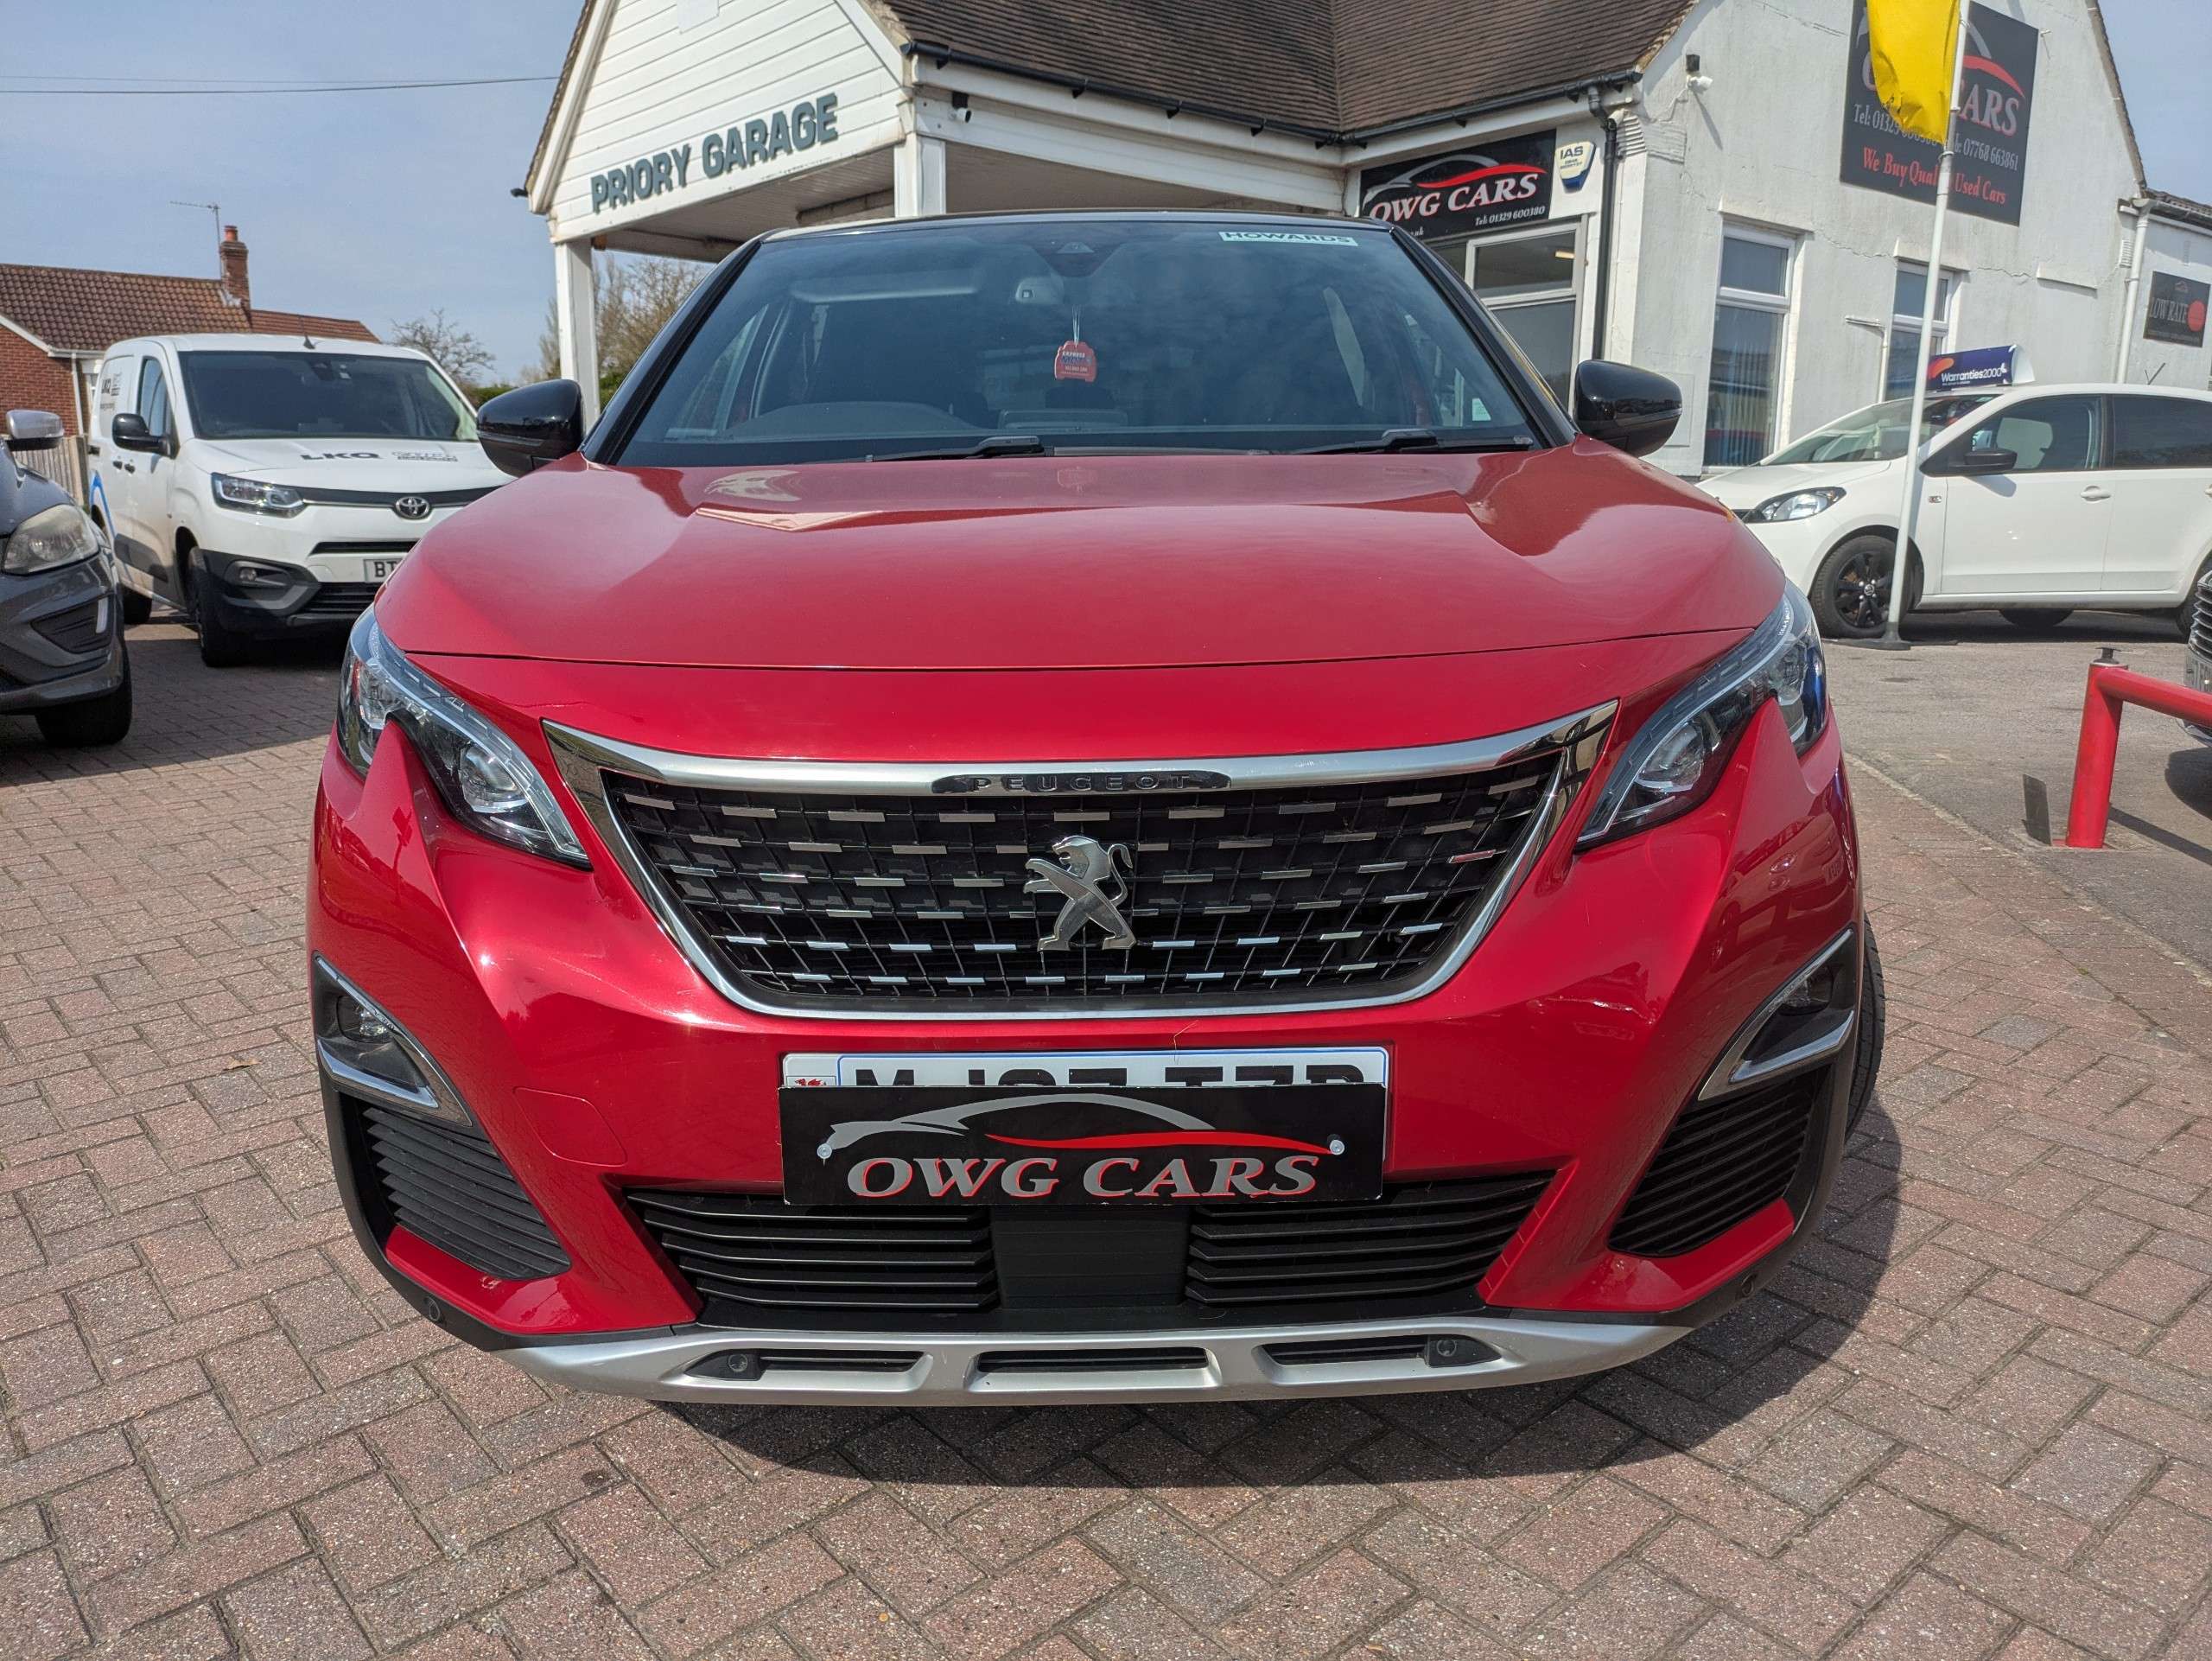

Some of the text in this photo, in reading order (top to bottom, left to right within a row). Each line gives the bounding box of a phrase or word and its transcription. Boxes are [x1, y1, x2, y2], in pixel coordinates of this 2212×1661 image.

[1958, 79, 2019, 137] ARS
[590, 92, 838, 213] PRIORY GARAGE
[1560, 145, 1584, 160] IAS
[1853, 104, 1870, 126] Tel:
[1963, 138, 1990, 162] 07768
[1990, 147, 2019, 171] 663861
[1864, 146, 2006, 205] We Buy Qual Used Cars
[1369, 173, 1540, 222] OWG CARS
[1475, 206, 1546, 226] Tel: 01329 600380
[1224, 232, 1351, 243] HOWARDS
[1941, 367, 2003, 383] Warranties2000
[301, 452, 383, 461] LKQ
[972, 774, 1191, 792] PEUGEOT
[847, 1155, 1320, 1199] OWG CARS
